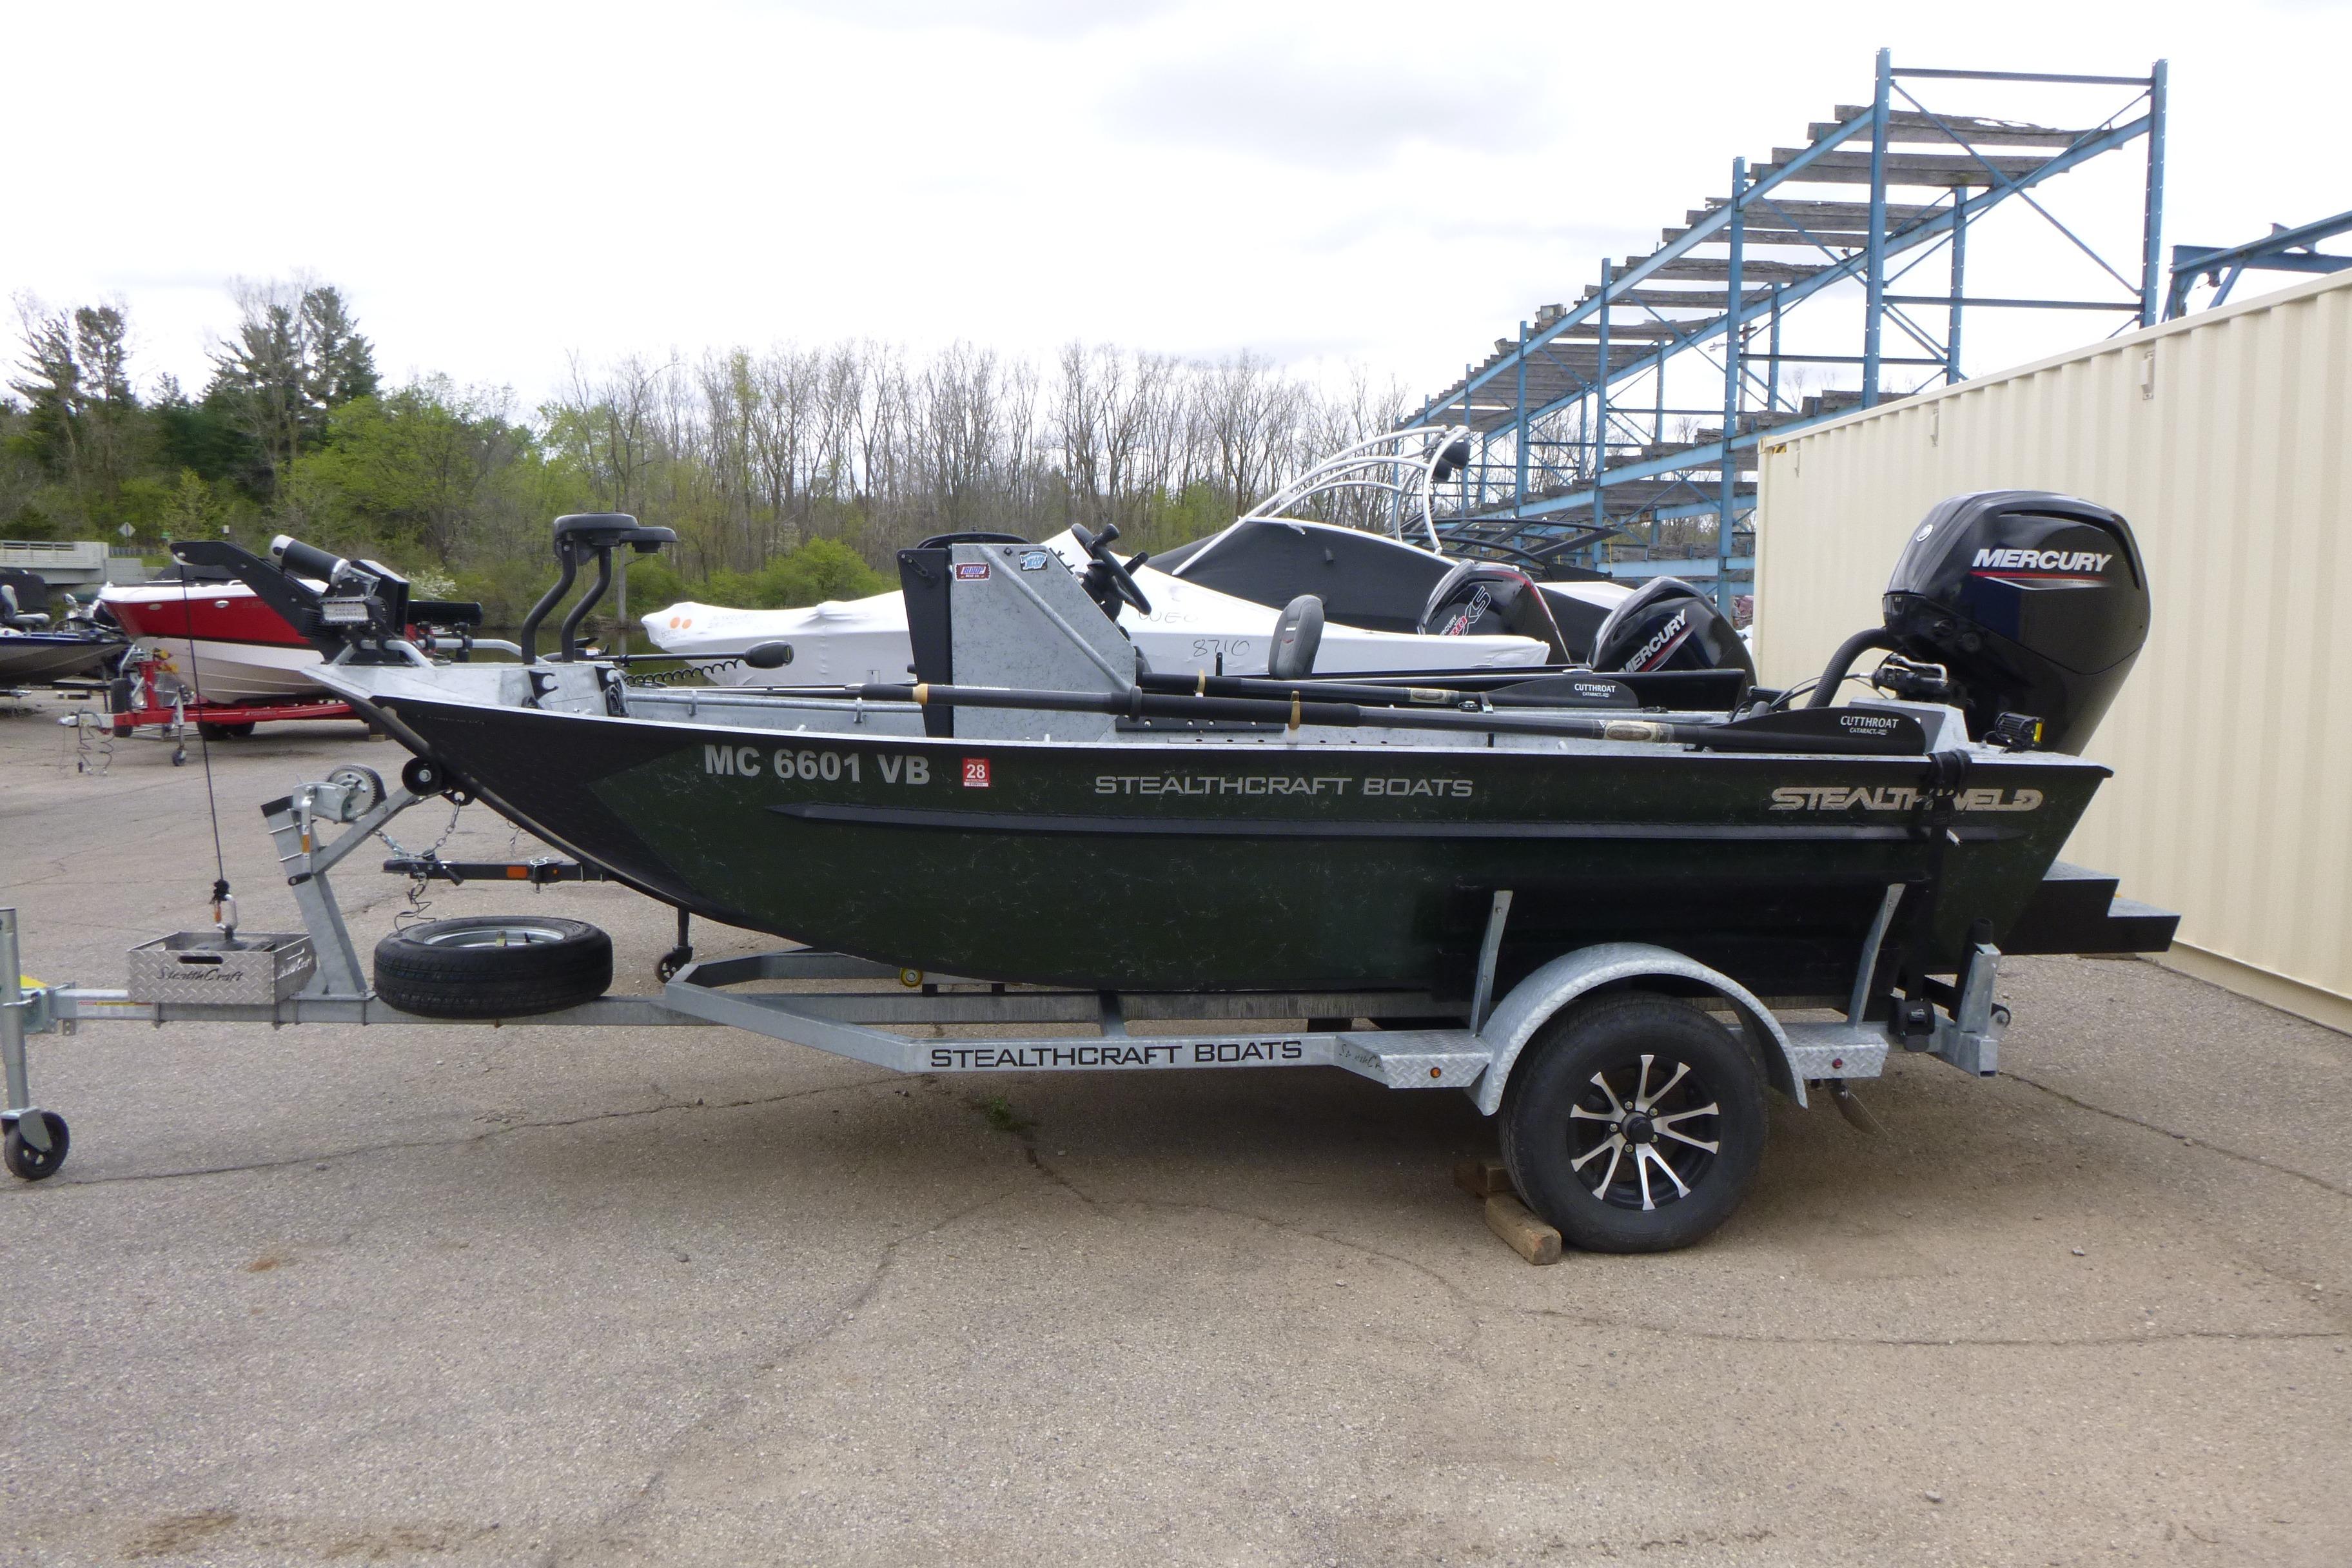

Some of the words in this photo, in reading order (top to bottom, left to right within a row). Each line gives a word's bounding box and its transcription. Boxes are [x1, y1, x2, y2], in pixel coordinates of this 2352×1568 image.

[1972, 548, 2113, 573] MERCURY
[1193, 639, 1250, 656] 8710
[1574, 683, 1616, 693] CUTTHROAT
[1840, 716, 1899, 729] CUTTHROAT
[704, 744, 761, 777] MC
[774, 749, 861, 783] 6601
[876, 754, 931, 785] VB
[966, 764, 986, 779] 28
[1095, 775, 1353, 795] STEALTHCRAFT
[1362, 778, 1474, 797] BOATS
[930, 1045, 1182, 1068] STEALTHCRAFT
[1195, 1040, 1303, 1063] BOATS
